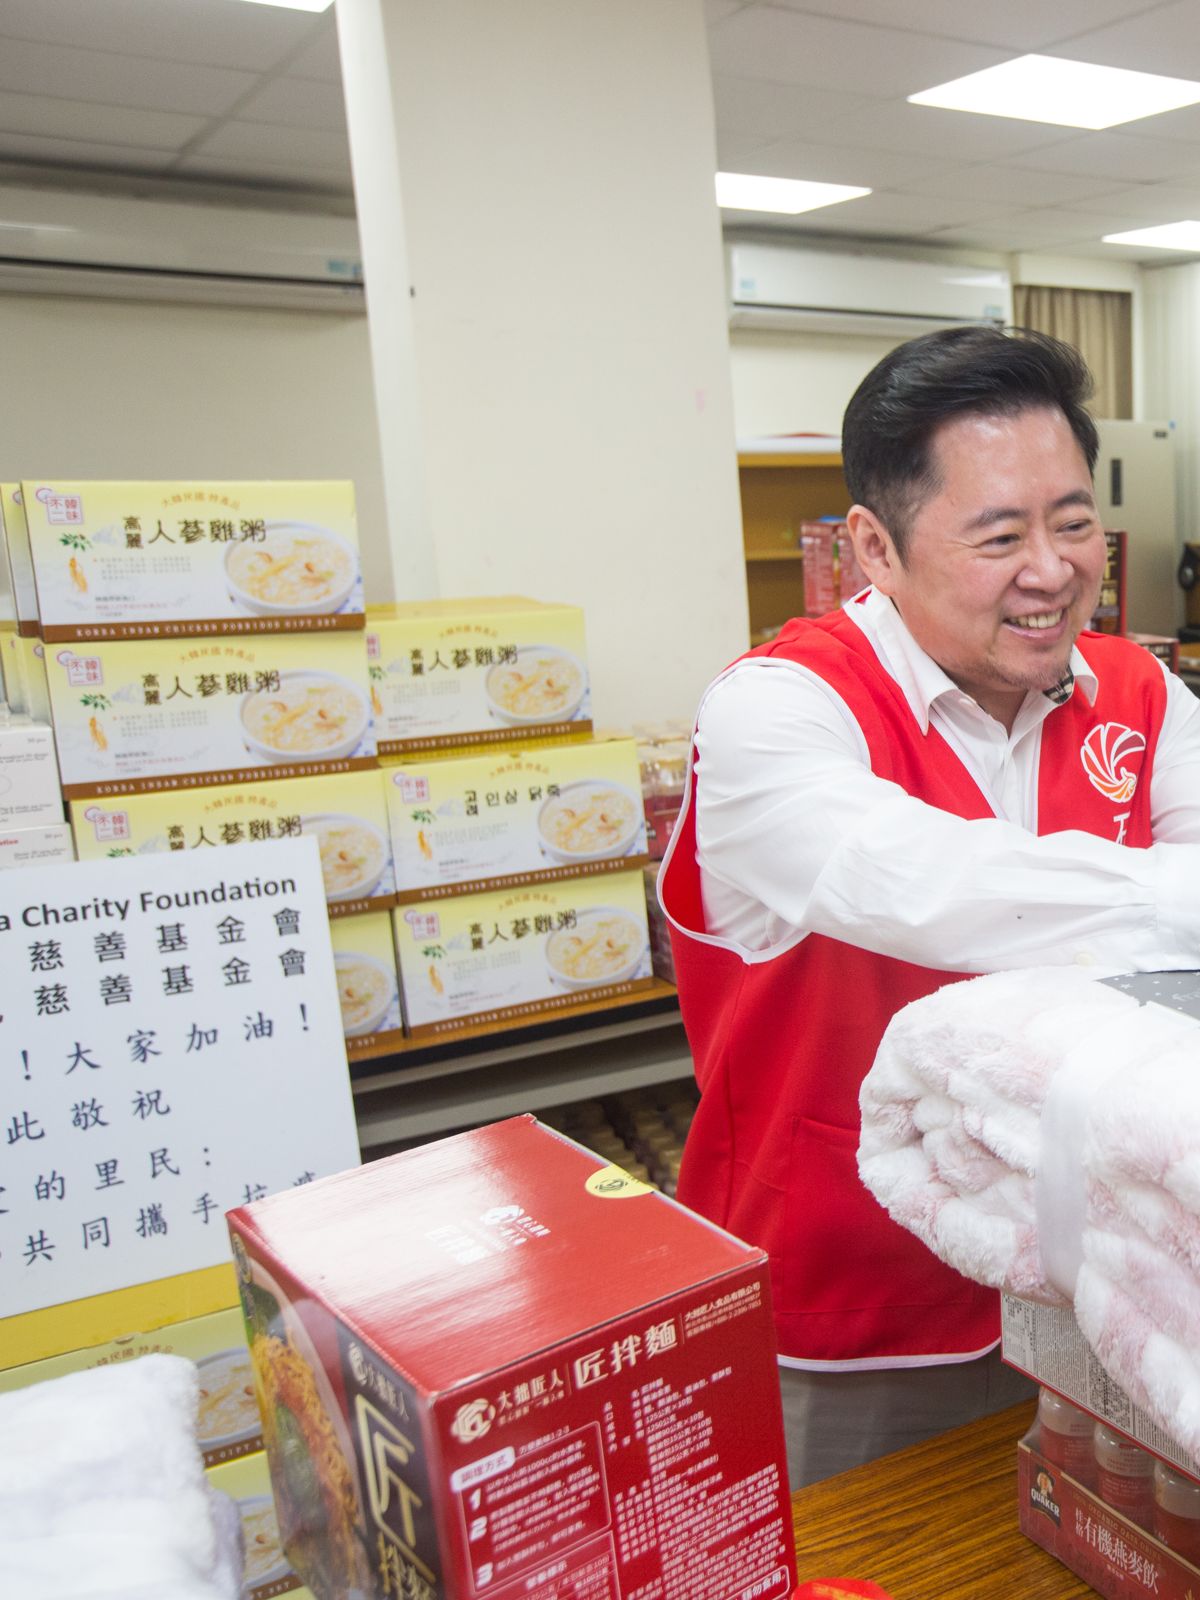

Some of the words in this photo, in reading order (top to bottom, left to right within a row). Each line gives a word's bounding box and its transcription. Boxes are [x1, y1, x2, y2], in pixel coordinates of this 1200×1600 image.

[123, 516, 144, 549] 高麗
[148, 519, 267, 545] 人蔘雞粥
[142, 673, 161, 706] 高麗
[166, 669, 281, 700] 人蔘雞粥
[191, 816, 302, 849] 人蔘雞粥
[22, 897, 130, 928] Charity
[140, 877, 297, 913] Foundation
[28, 907, 301, 972] 慈善基金會
[34, 947, 307, 1017] 慈善基金會
[7, 1089, 171, 1145] 此敬祝
[573, 1318, 678, 1390] 匠拌麵
[470, 1488, 481, 1511] 1
[1031, 1488, 1060, 1518] QUAKER
[470, 1515, 487, 1542] 2
[1084, 1516, 1159, 1595] 有機燕麥飲
[476, 1562, 493, 1589] 3
